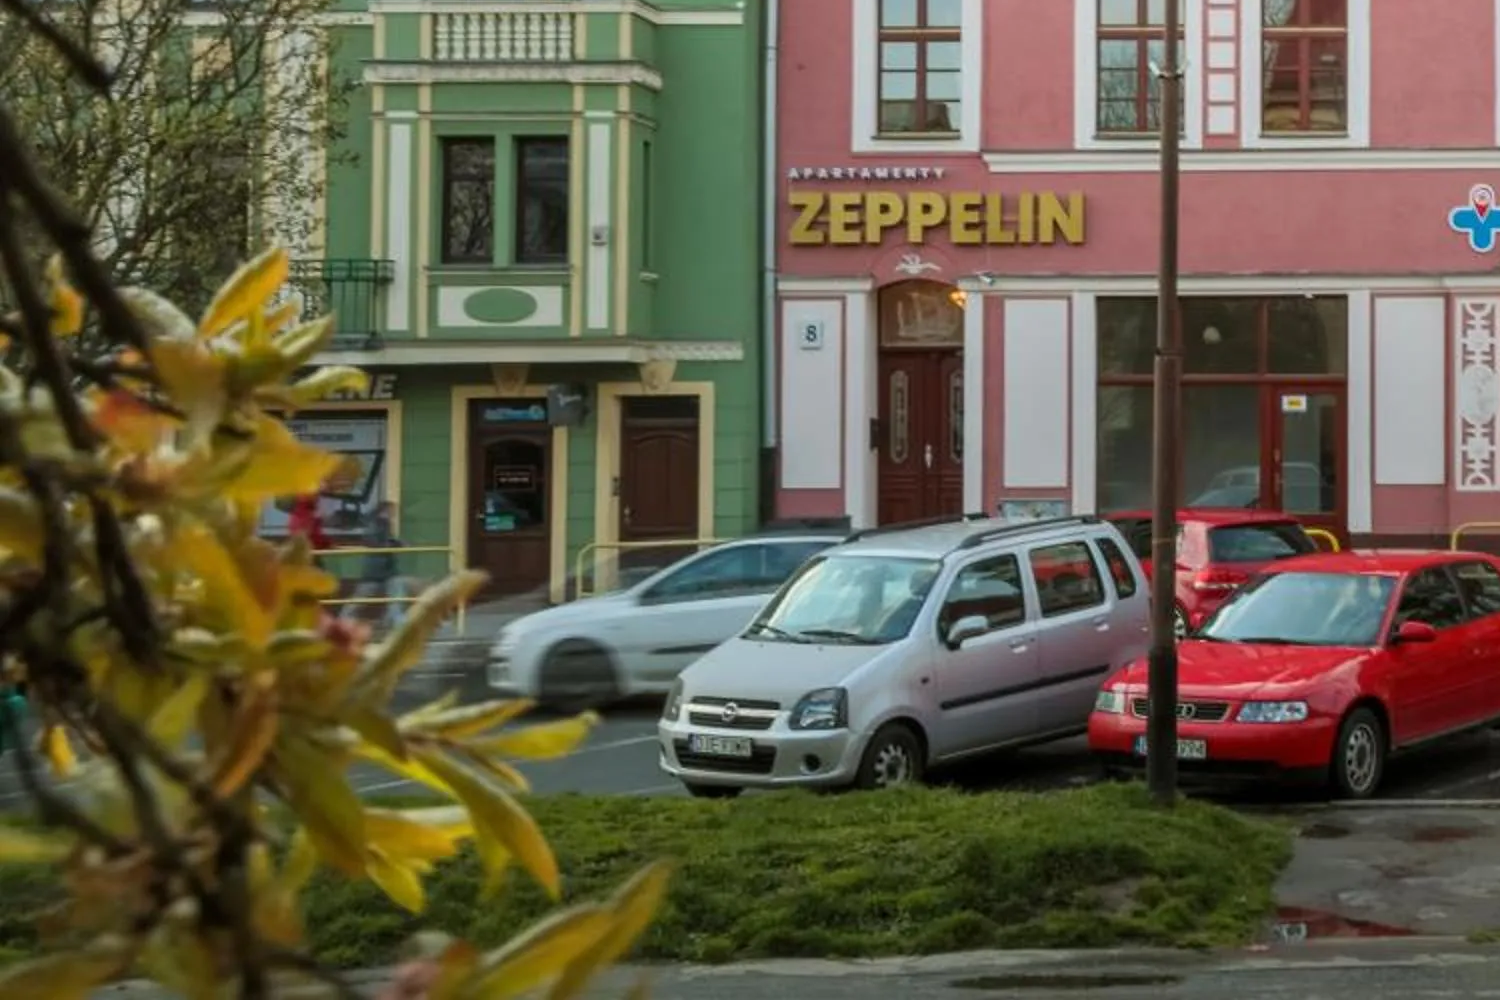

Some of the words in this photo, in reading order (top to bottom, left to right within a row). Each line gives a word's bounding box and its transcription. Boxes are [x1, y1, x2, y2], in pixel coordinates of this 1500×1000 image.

[788, 166, 947, 180] APARTAMENTY
[788, 190, 1085, 245] ZEPPELIN
[805, 324, 817, 342] 8
